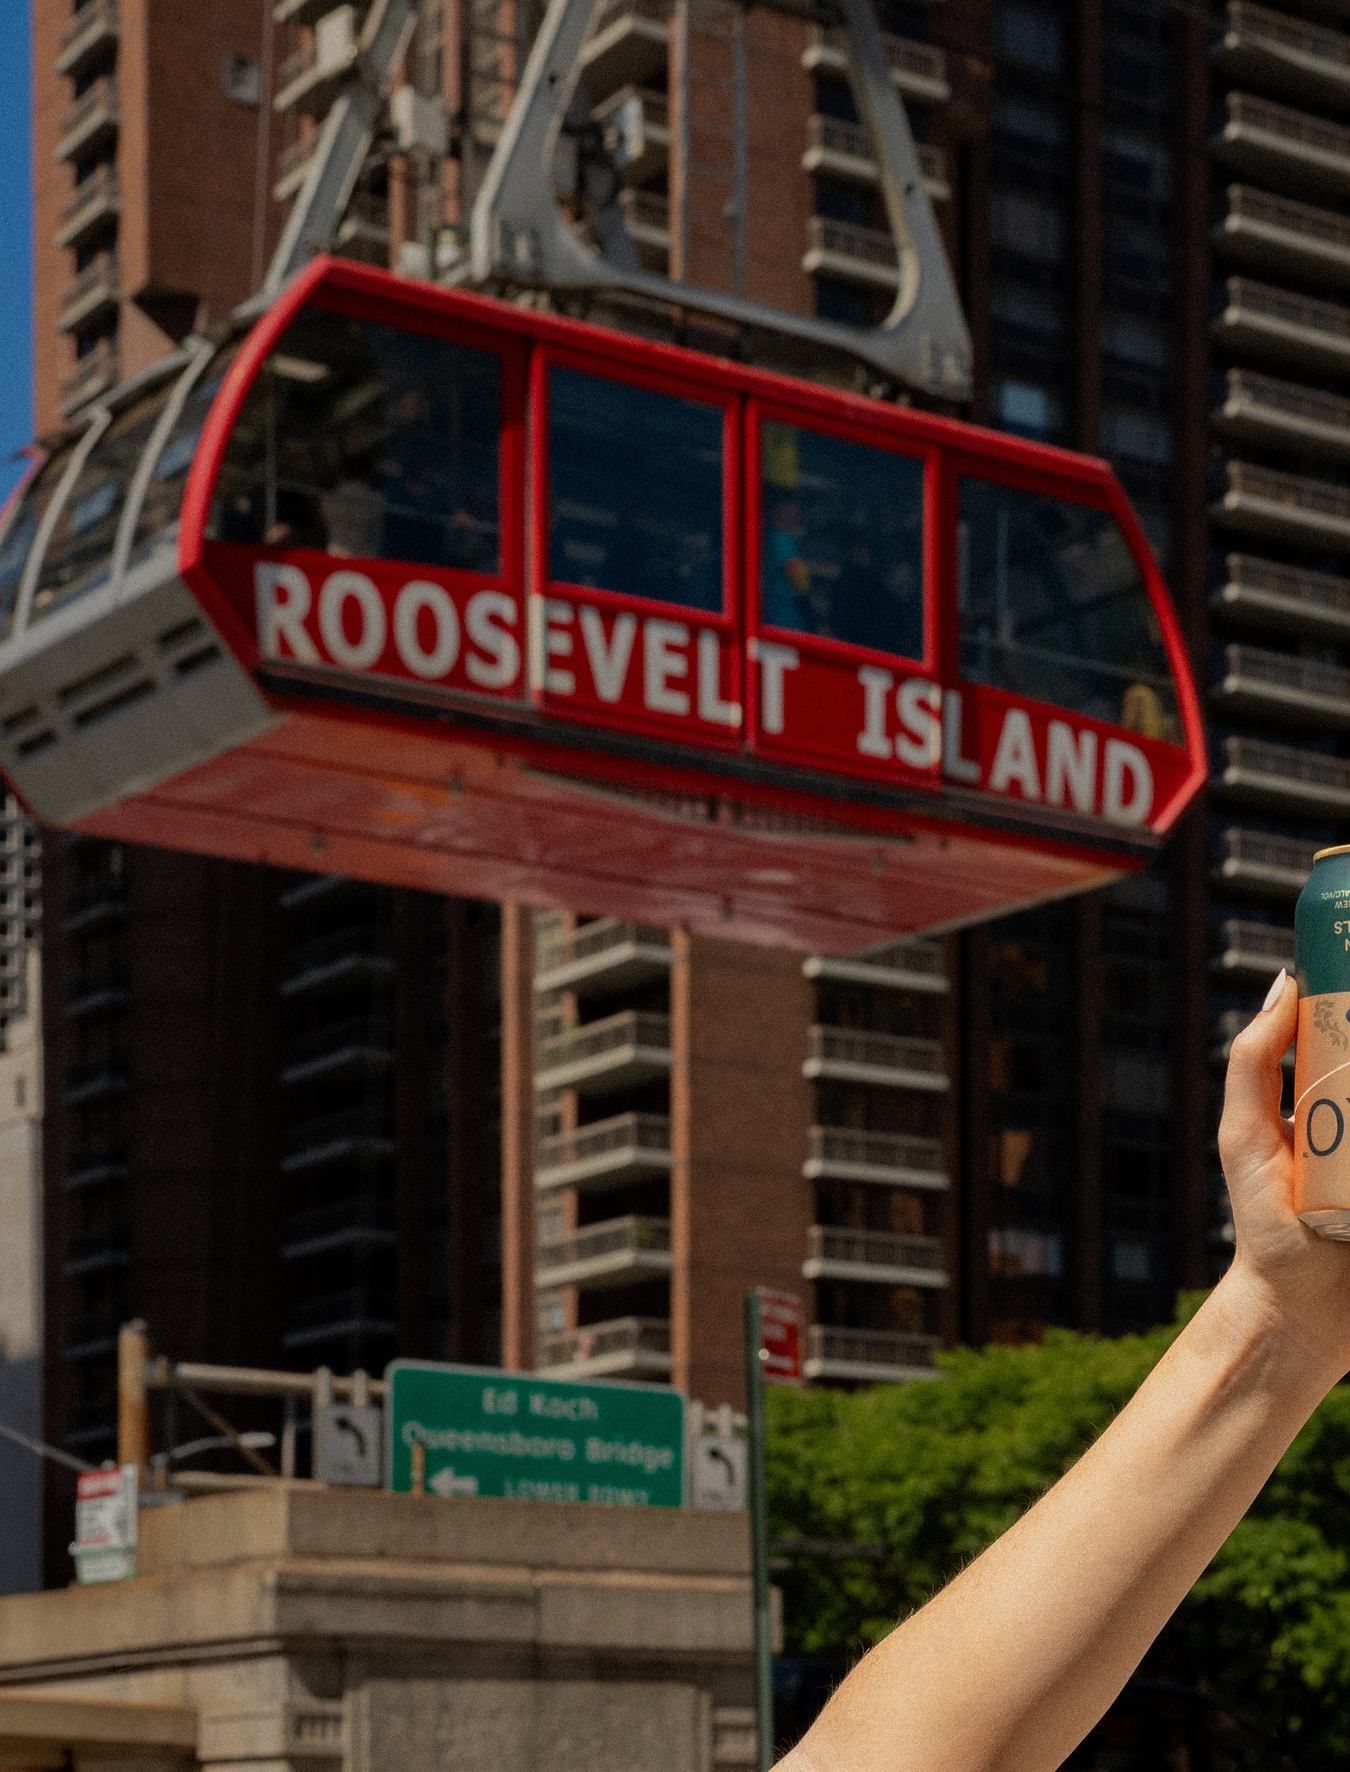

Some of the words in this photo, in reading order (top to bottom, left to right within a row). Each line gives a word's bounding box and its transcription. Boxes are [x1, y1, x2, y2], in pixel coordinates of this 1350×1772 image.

[253, 560, 799, 735] ROOSEVELT
[856, 666, 1156, 826] ISLAND
[1320, 888, 1350, 900] ALC/VOL
[482, 1386, 518, 1415] Ed
[529, 1392, 599, 1422] Koch
[402, 1421, 577, 1462] Queensboro
[585, 1437, 675, 1474] Bridge
